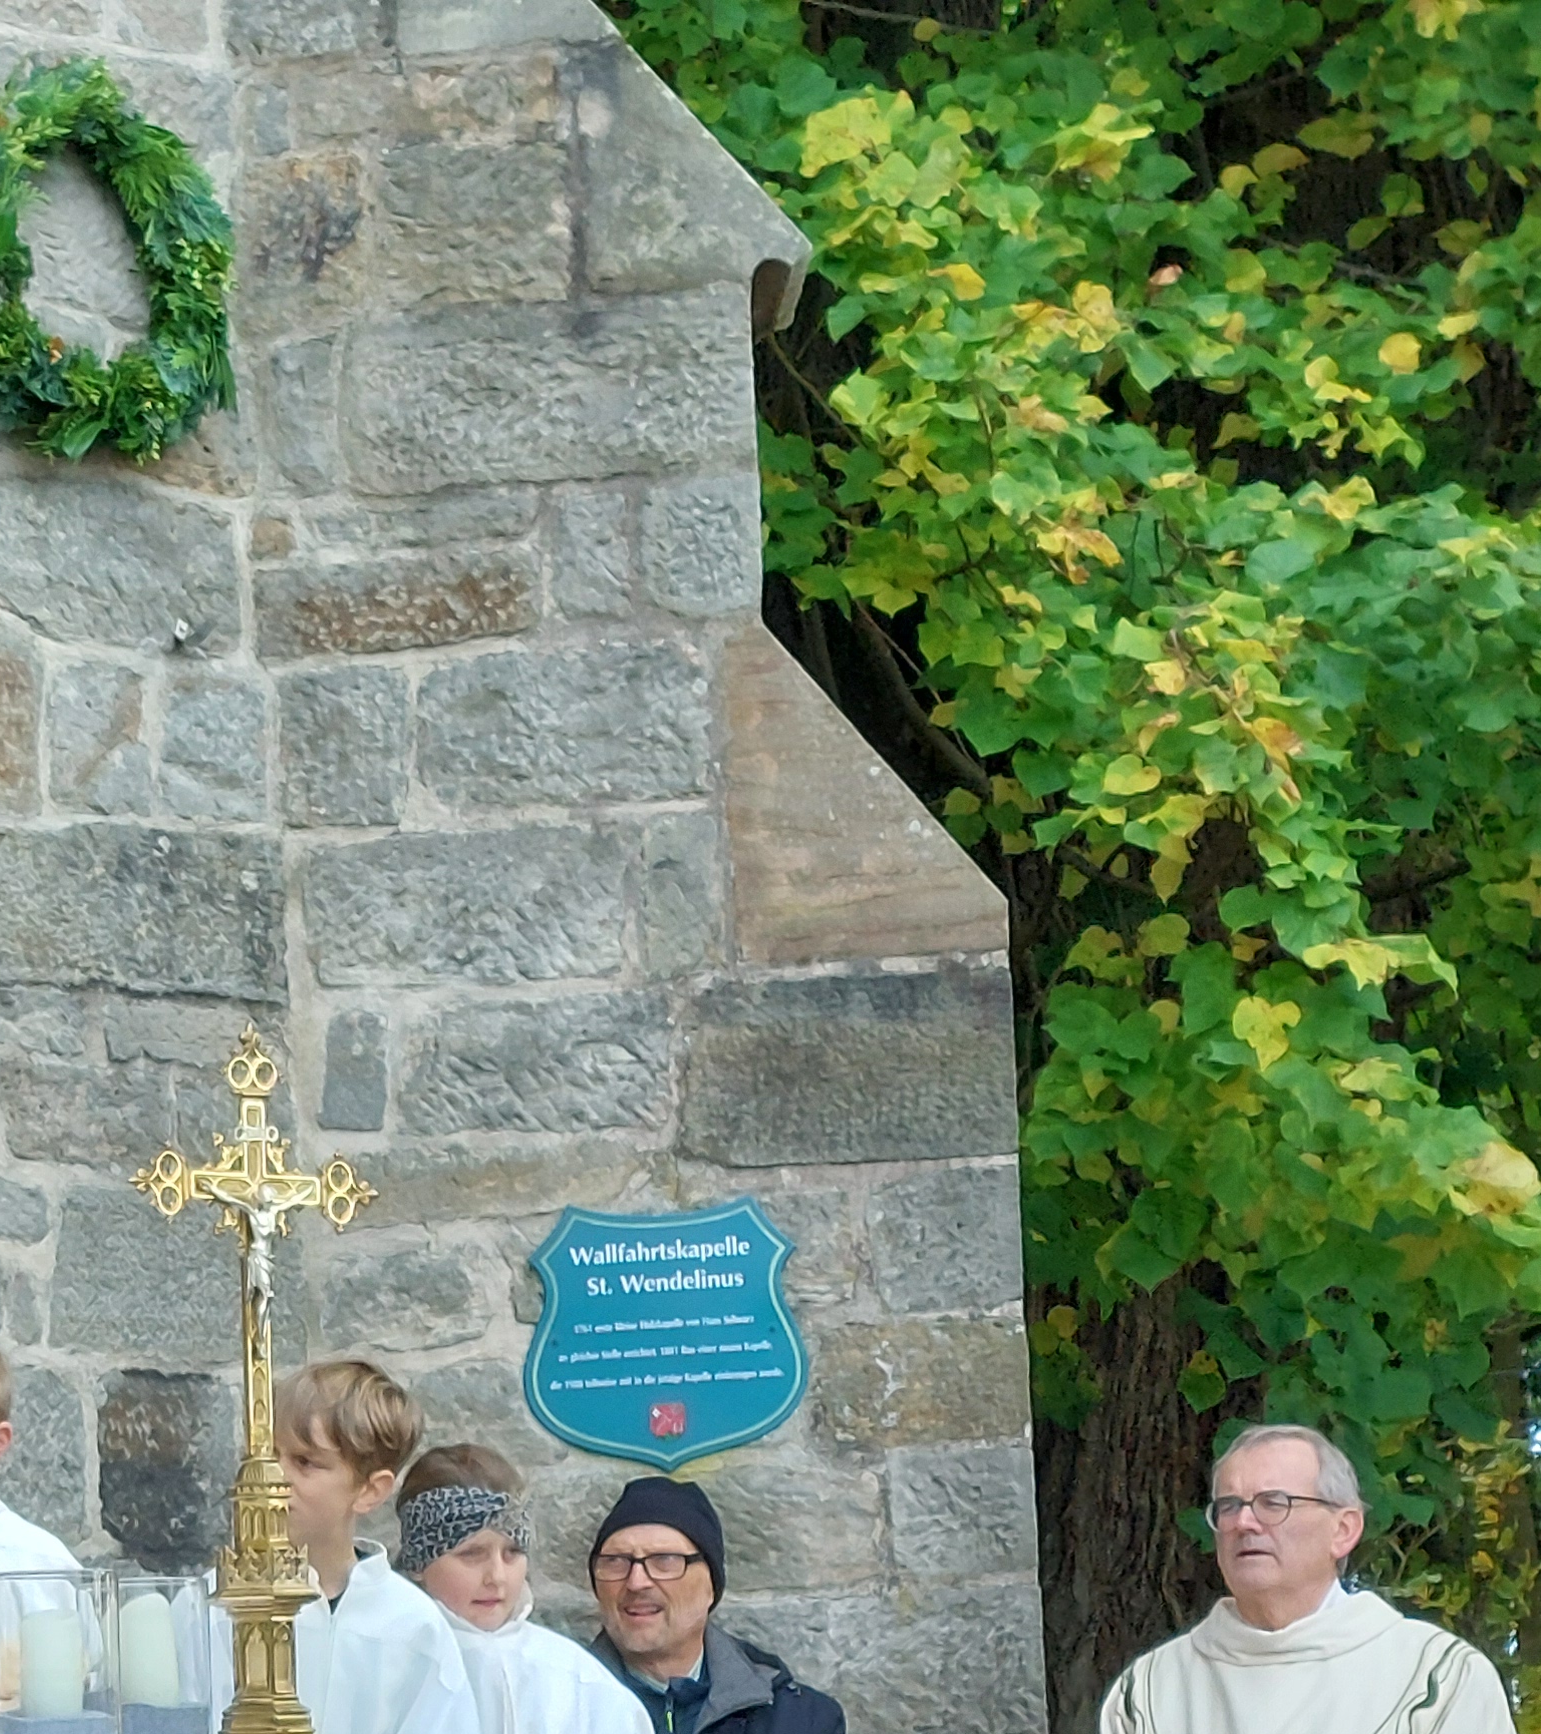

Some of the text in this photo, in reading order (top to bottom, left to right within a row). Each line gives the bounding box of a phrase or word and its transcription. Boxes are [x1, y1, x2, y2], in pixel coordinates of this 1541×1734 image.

[569, 1235, 751, 1267] Wallfahrtskapelle
[586, 1268, 745, 1296] St. Wendelinus
